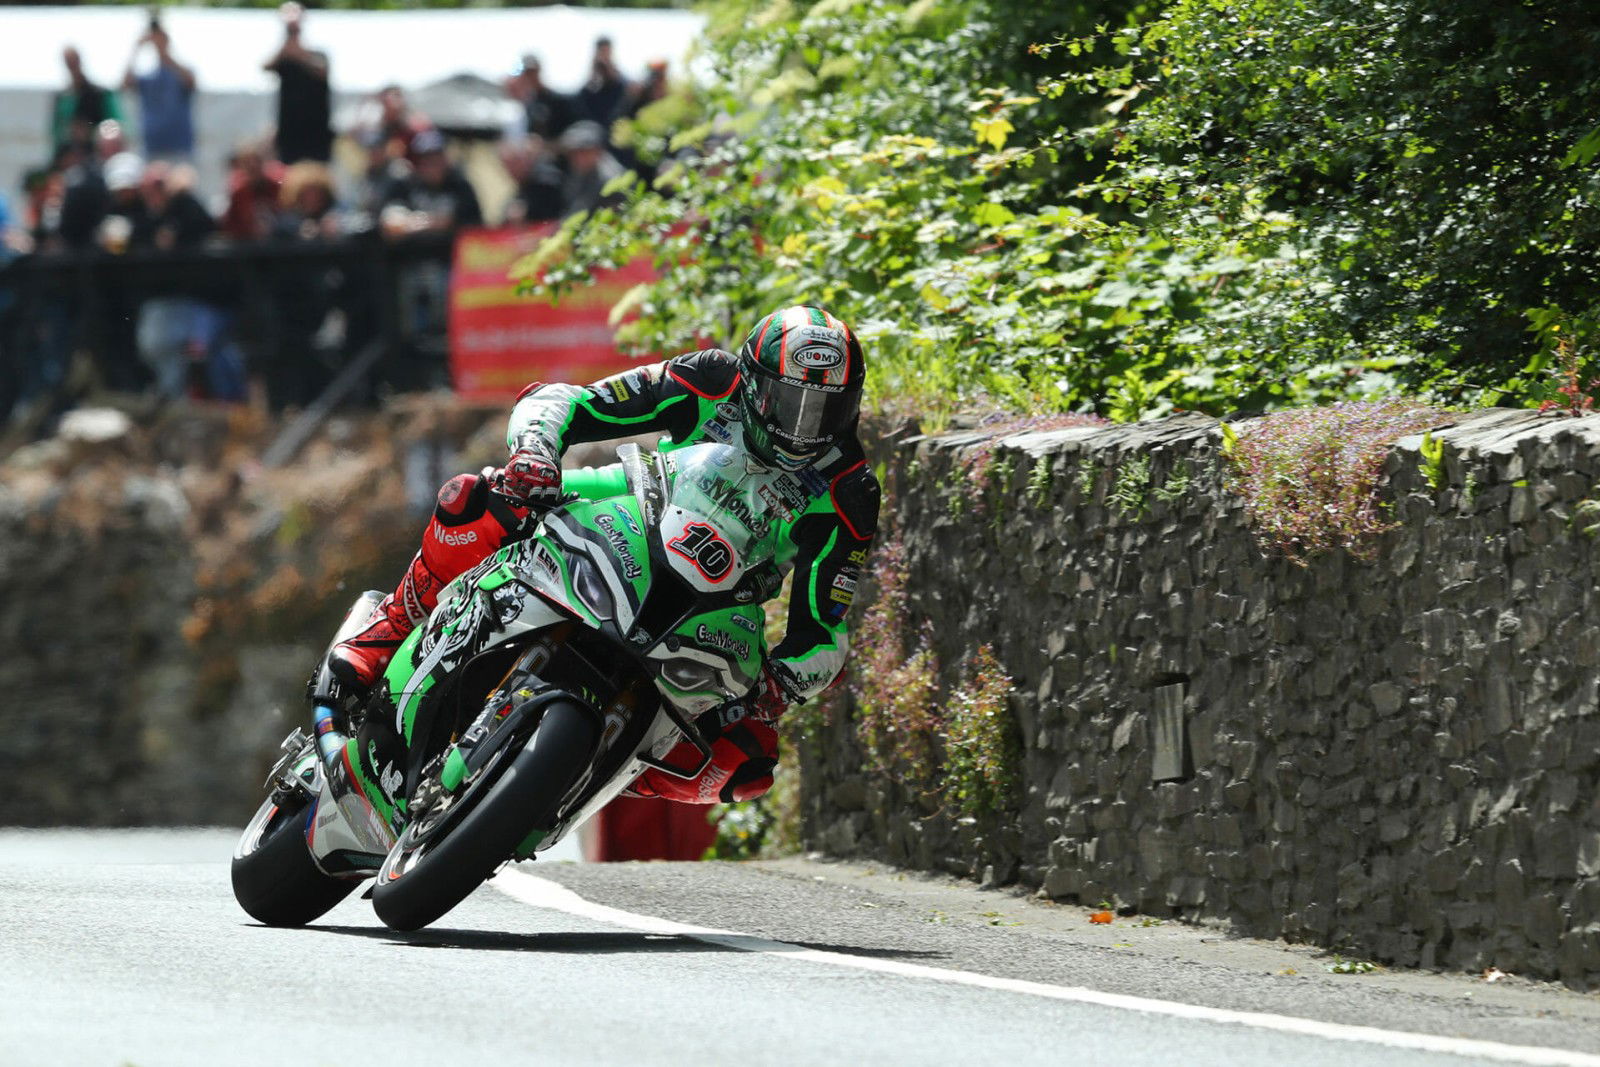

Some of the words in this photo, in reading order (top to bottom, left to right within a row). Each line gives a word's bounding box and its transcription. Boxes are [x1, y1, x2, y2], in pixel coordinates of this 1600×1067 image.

[798, 351, 841, 363] SUOMY
[781, 376, 821, 391] NOLAN
[774, 428, 827, 443] CasinoCoin.im
[774, 482, 804, 513] ROBOTS
[779, 475, 807, 509] GLOBAL
[433, 520, 478, 546] Weise
[537, 548, 559, 575] LEW
[670, 523, 734, 579] 10
